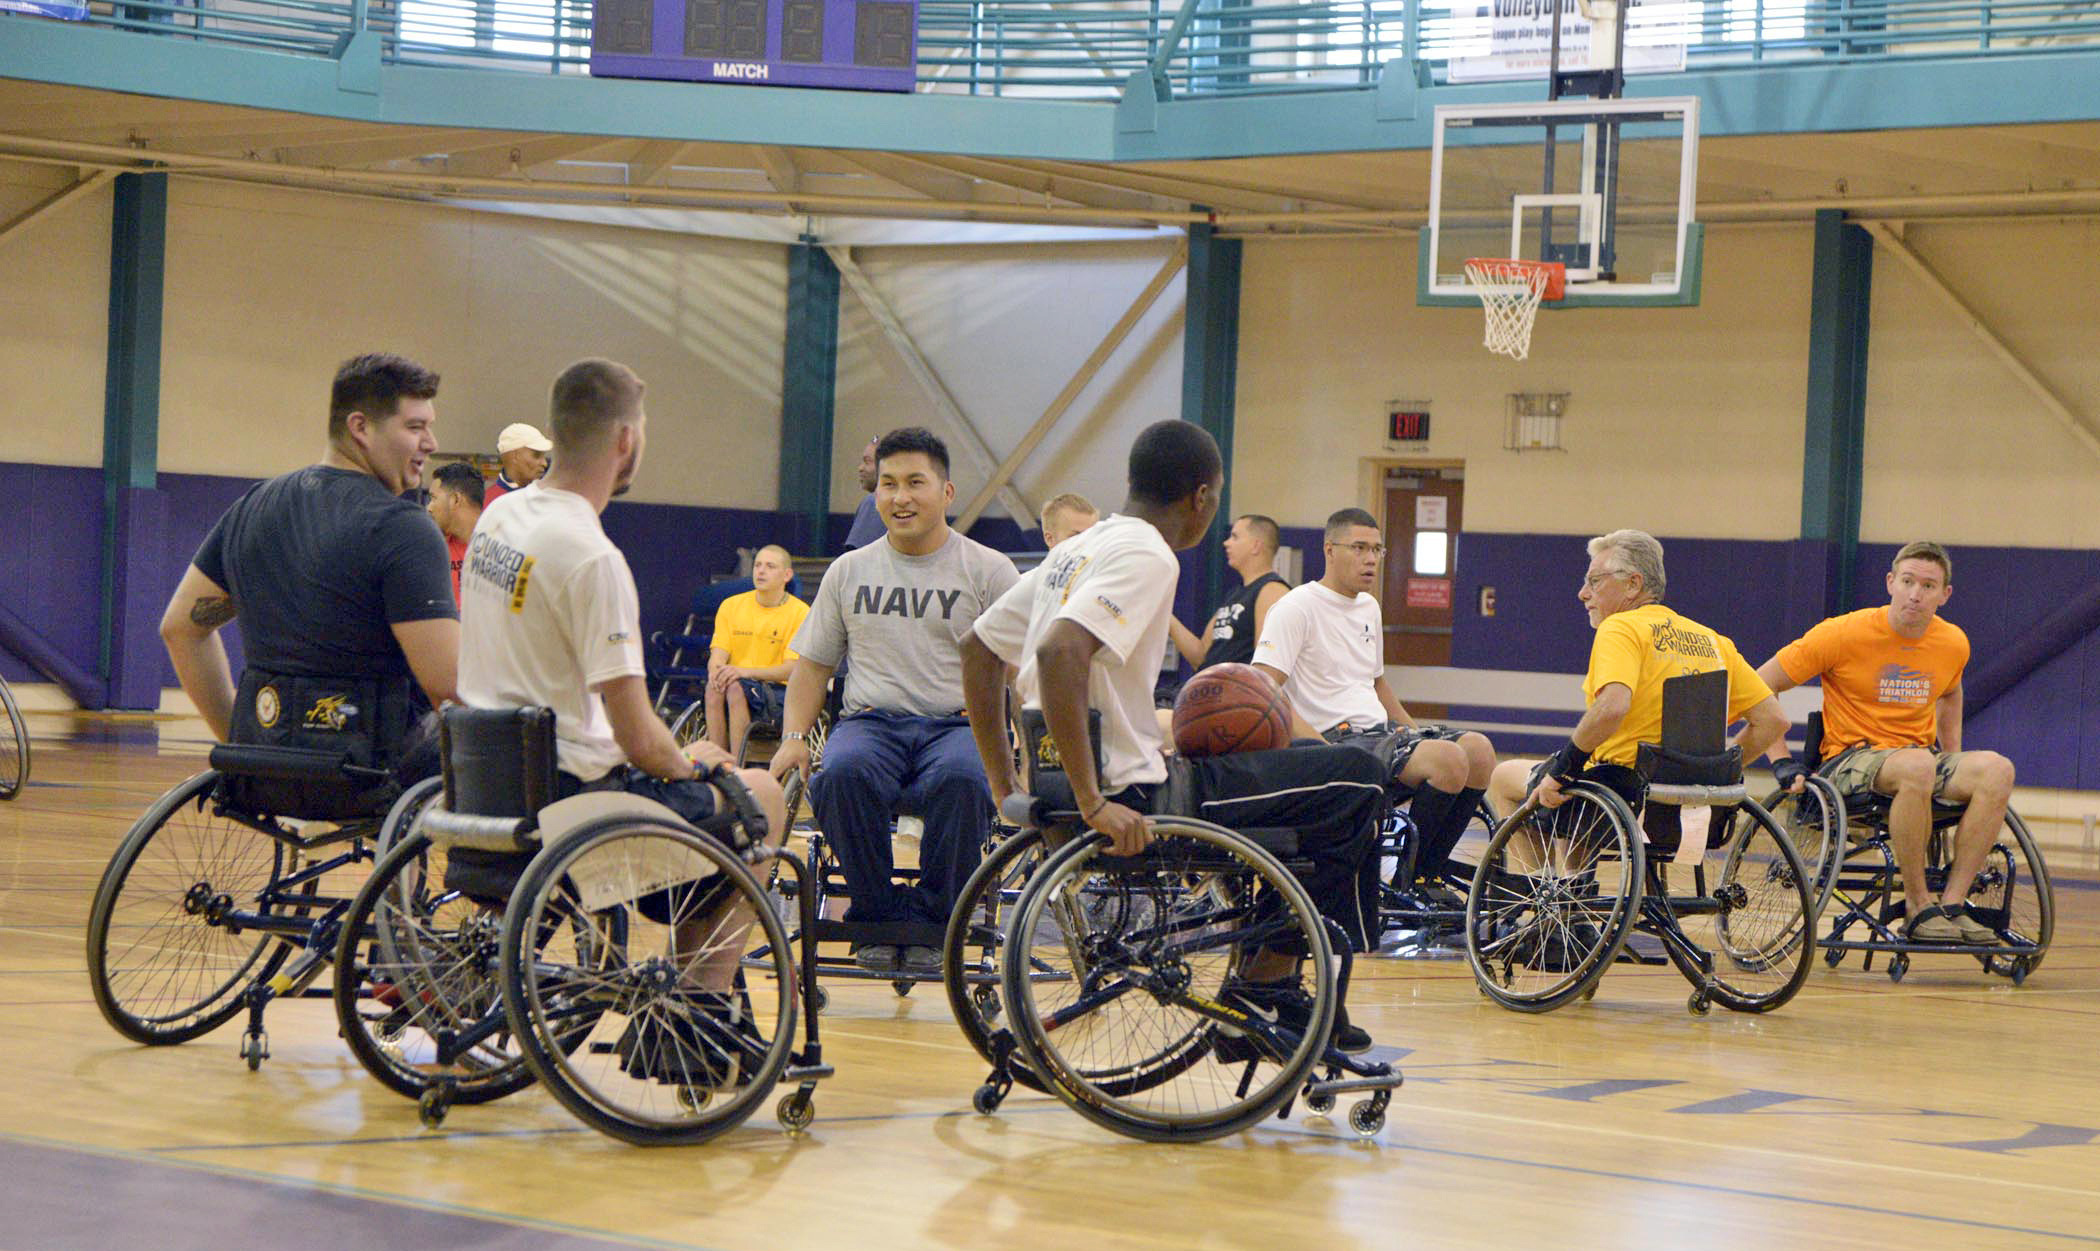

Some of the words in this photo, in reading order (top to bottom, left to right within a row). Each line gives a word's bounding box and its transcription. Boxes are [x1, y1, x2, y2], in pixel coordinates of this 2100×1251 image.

[1493, 0, 1576, 20] Volleybll
[1518, 27, 1533, 39] play
[713, 62, 769, 79] MATCH
[1396, 414, 1420, 436] EXIT
[470, 556, 517, 594] WARRIOR
[853, 585, 961, 619] NAVY
[1649, 623, 1712, 647] WOUNDED
[1666, 639, 1718, 658] WARRIOR
[1880, 679, 1930, 689] NATION'S
[1880, 688, 1929, 697] TRIATHLON
